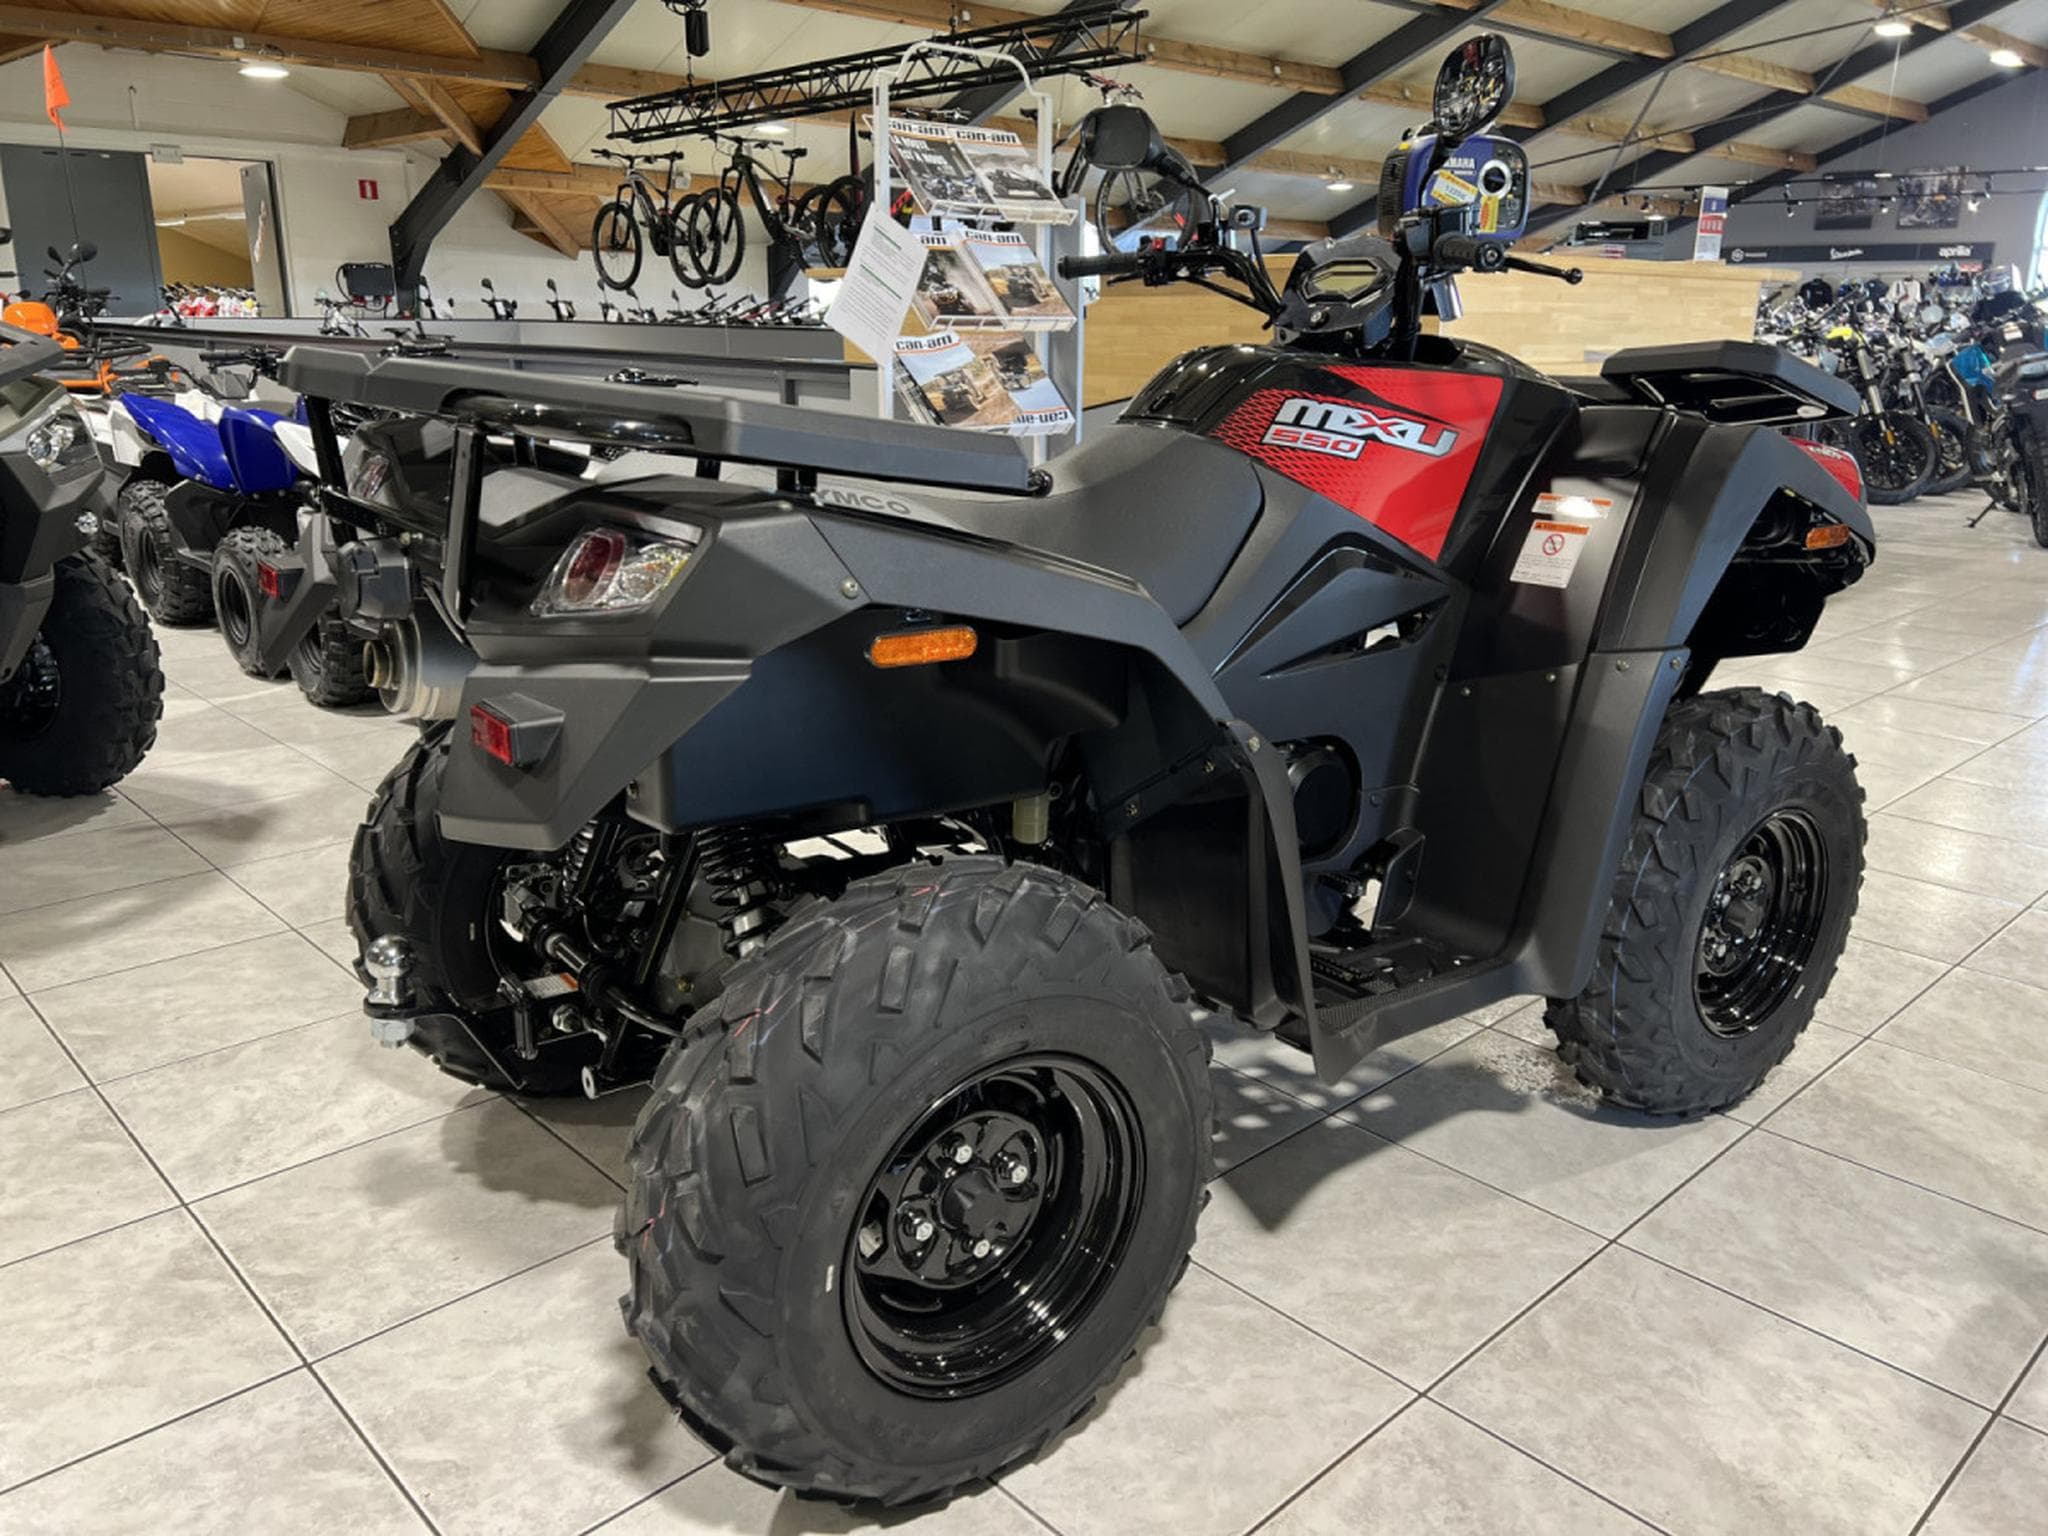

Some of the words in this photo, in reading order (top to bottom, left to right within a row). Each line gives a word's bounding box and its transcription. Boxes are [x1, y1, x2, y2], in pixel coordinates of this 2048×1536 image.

[956, 130, 1017, 144] can-am
[1443, 157, 1475, 170] AMAHA
[965, 231, 1022, 244] can-am
[895, 334, 953, 350] can-am
[1271, 427, 1361, 454] 550
[815, 489, 912, 515] YMCO
